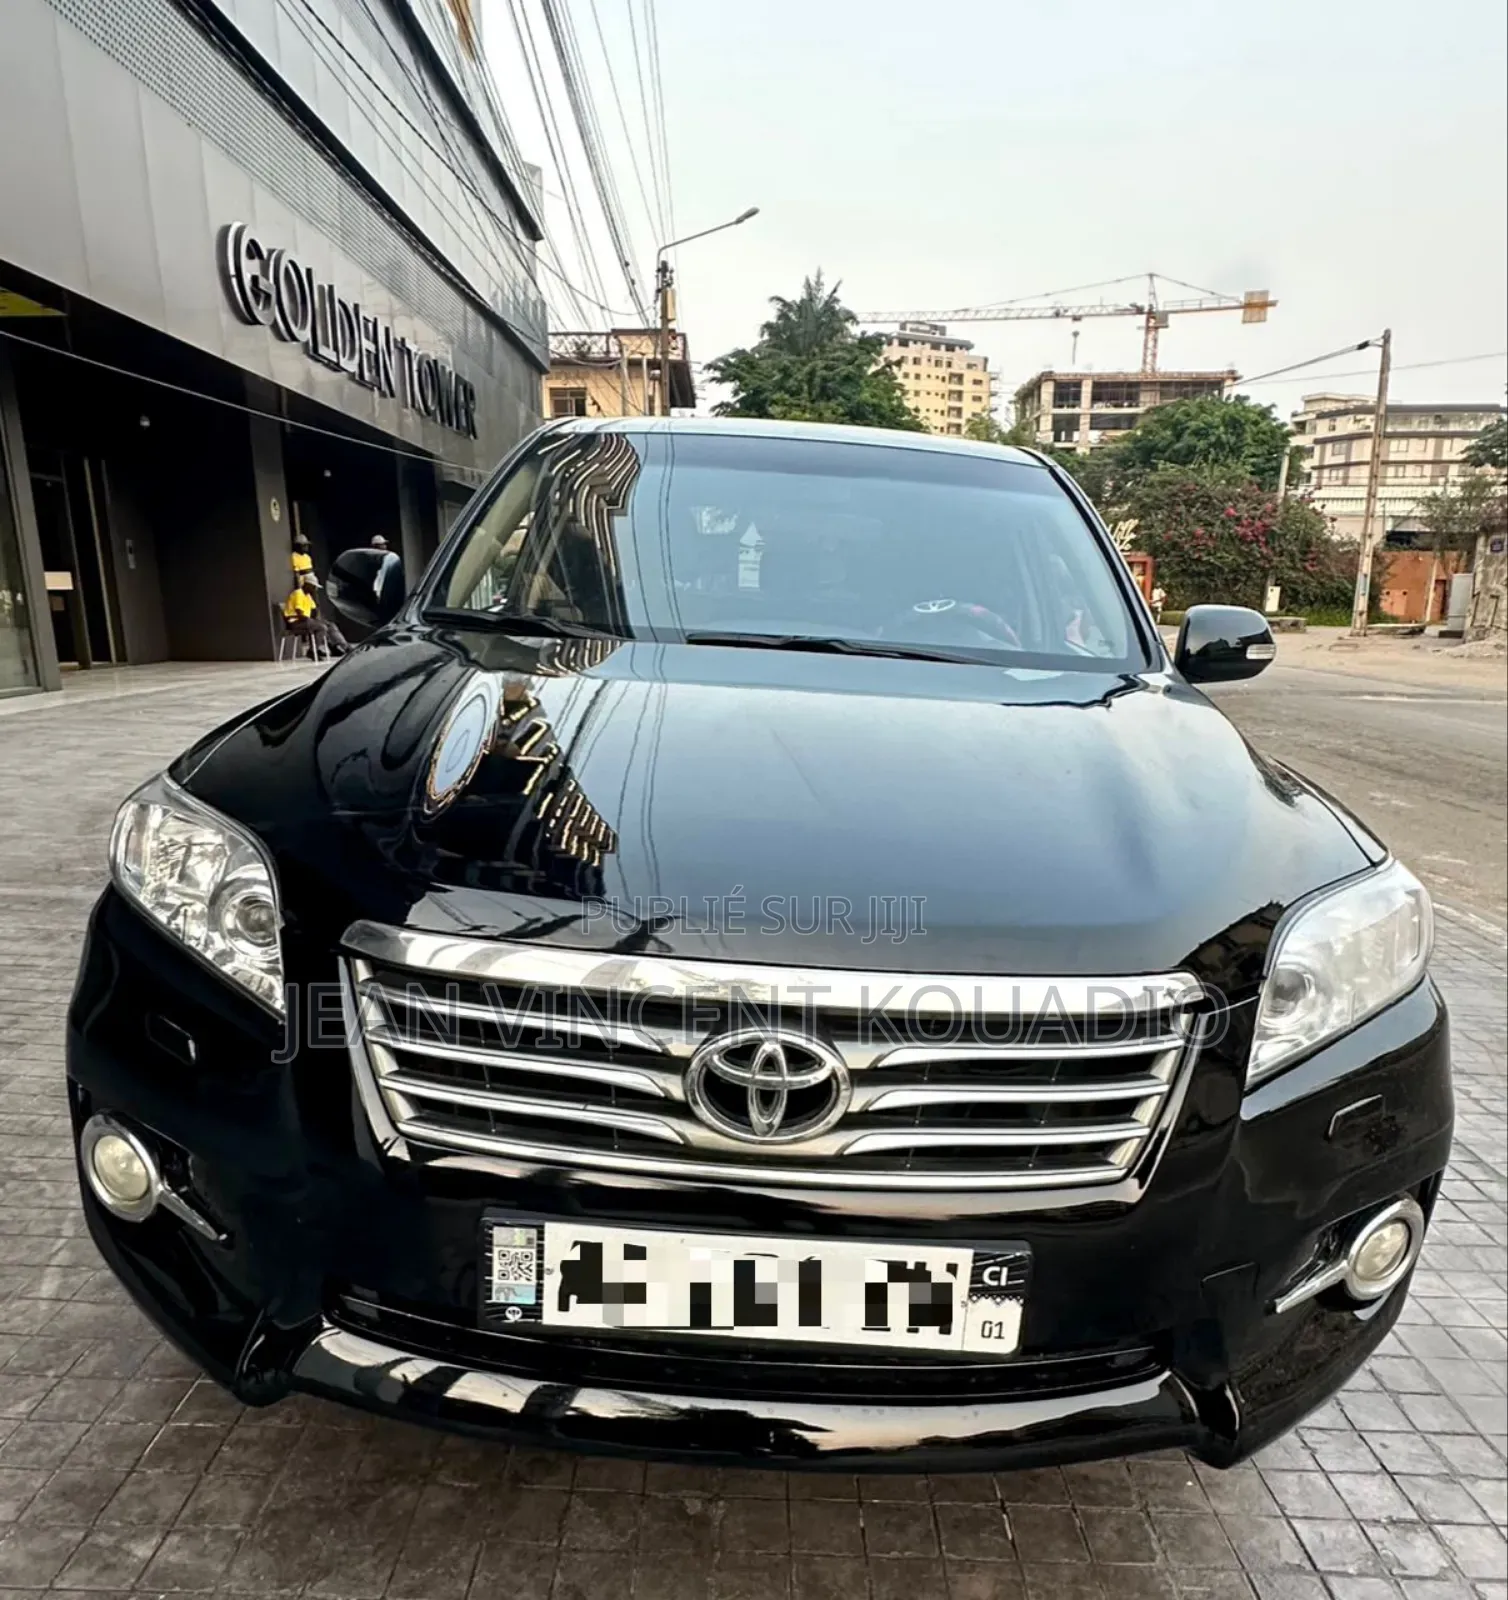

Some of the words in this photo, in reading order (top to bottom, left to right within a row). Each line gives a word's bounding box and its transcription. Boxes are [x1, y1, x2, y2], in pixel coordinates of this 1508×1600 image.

[216, 221, 396, 398] GOLDEN
[394, 337, 477, 440] TOWER
[982, 1265, 1009, 1287] CI
[980, 1319, 1005, 1340] 01
